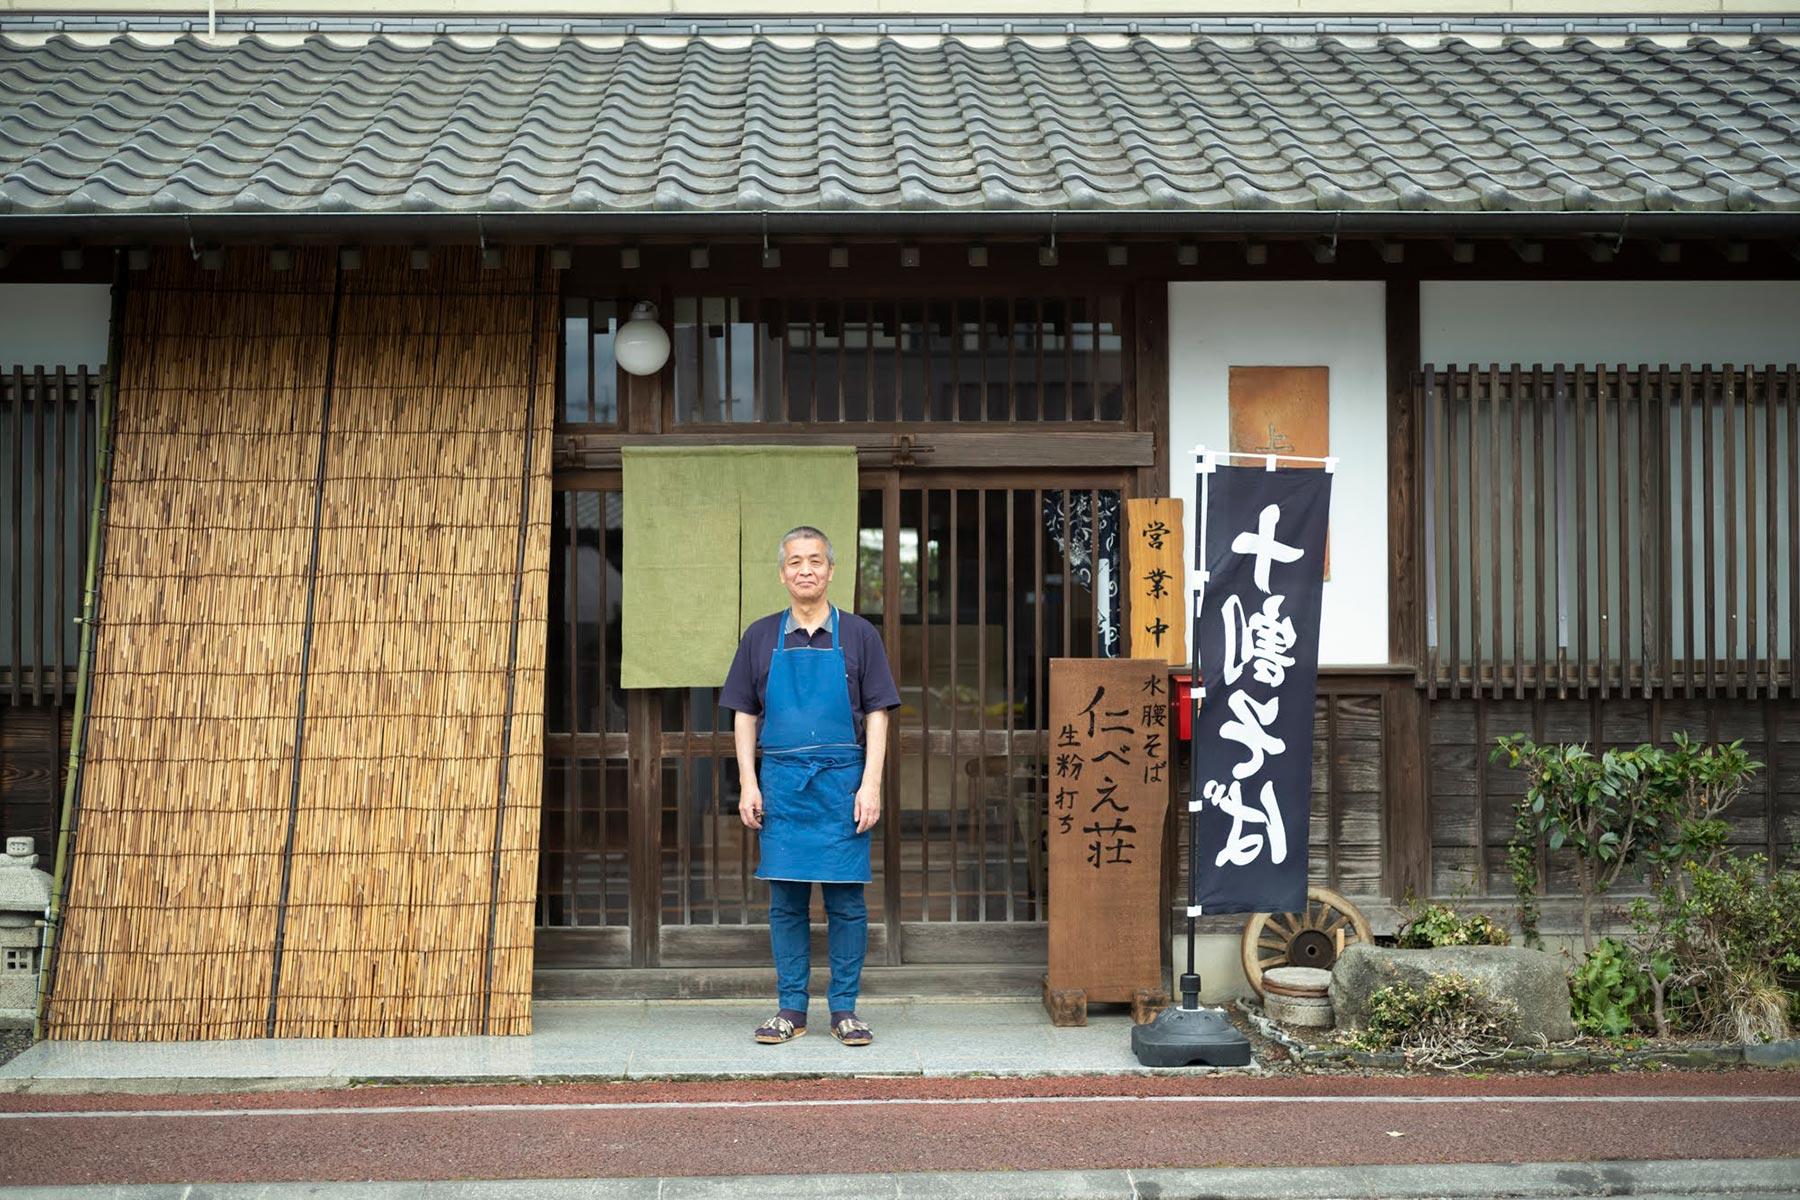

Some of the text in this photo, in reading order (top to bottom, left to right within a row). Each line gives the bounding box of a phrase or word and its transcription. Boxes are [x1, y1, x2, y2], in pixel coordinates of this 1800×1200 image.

[1142, 520, 1173, 648] 営業中
[1054, 723, 1085, 835] 生粉打ち
[1077, 685, 1137, 869] 仁べえ荘
[1141, 673, 1168, 785] 水腰そば
